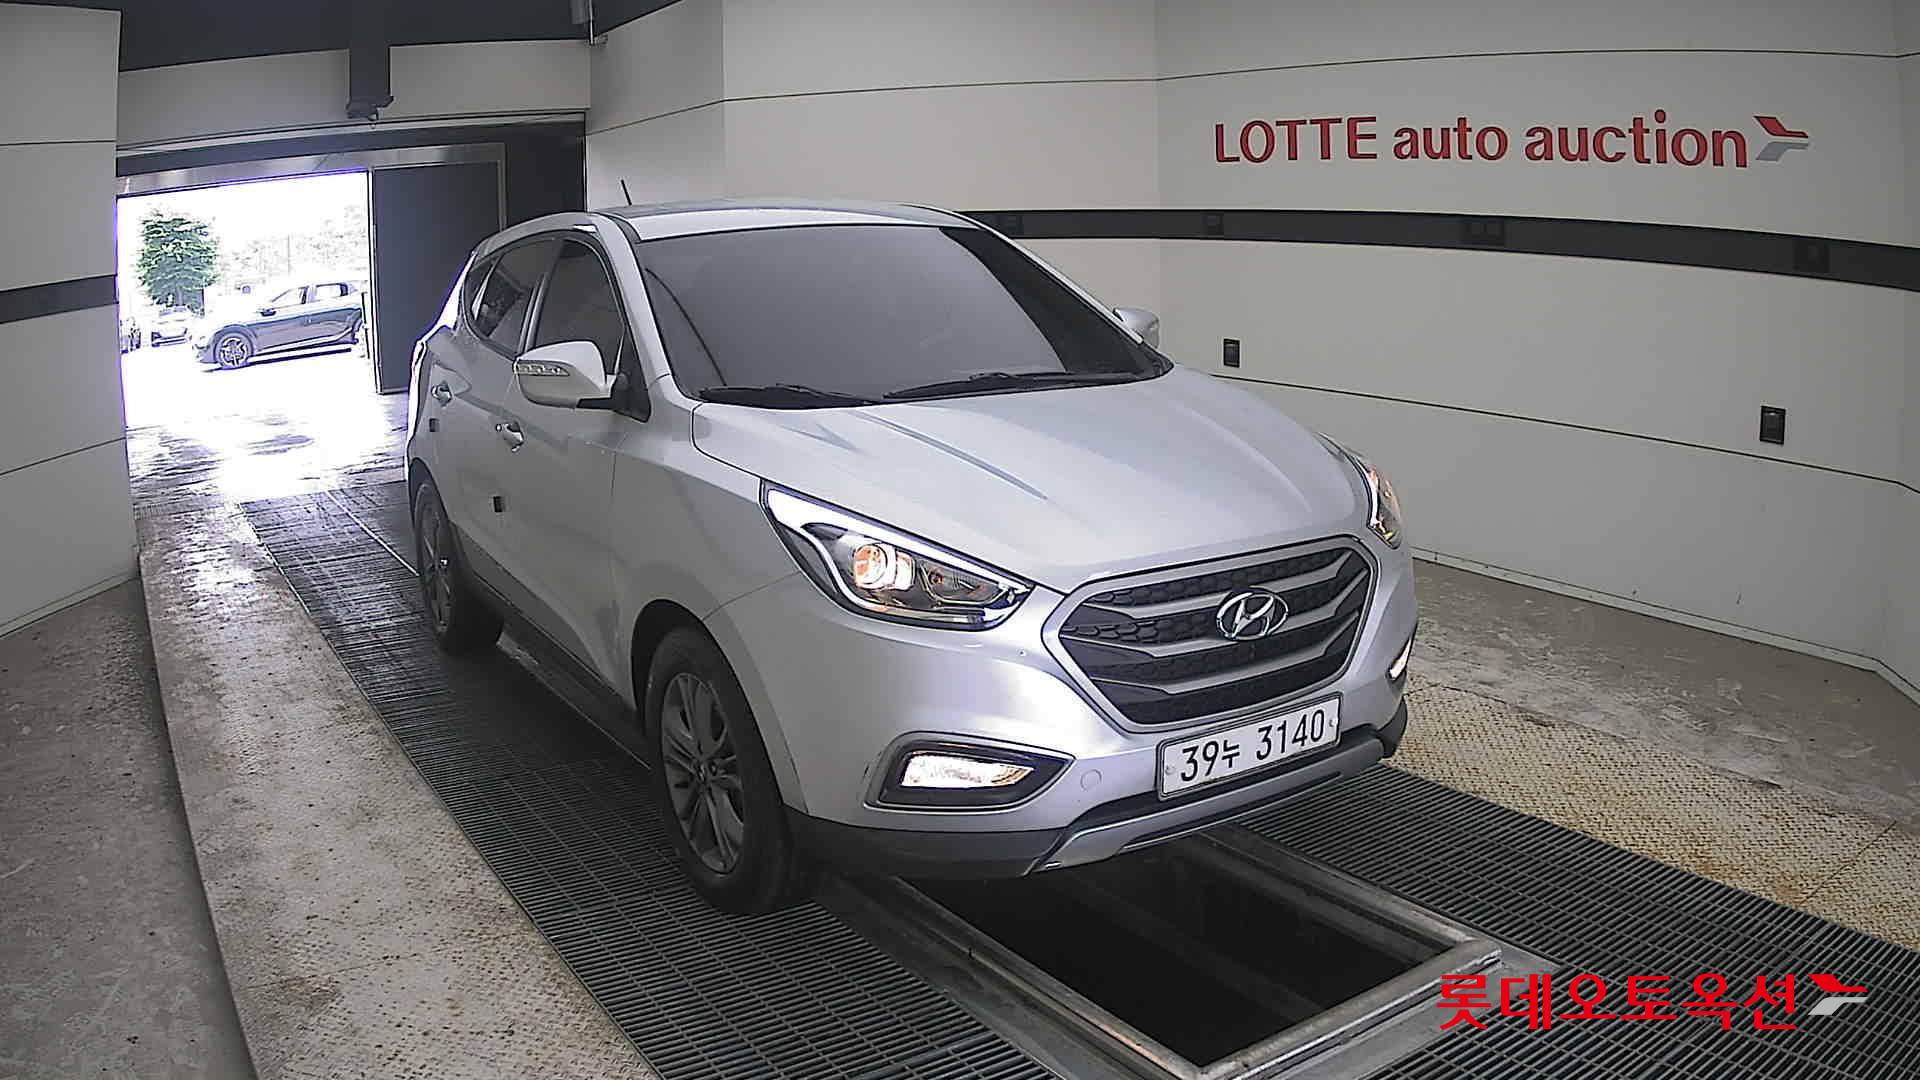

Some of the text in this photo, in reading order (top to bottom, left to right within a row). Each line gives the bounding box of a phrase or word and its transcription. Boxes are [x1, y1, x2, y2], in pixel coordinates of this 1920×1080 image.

[1215, 108, 1748, 168] LOTTE auto auction
[1180, 709, 1325, 781] 39누 3140
